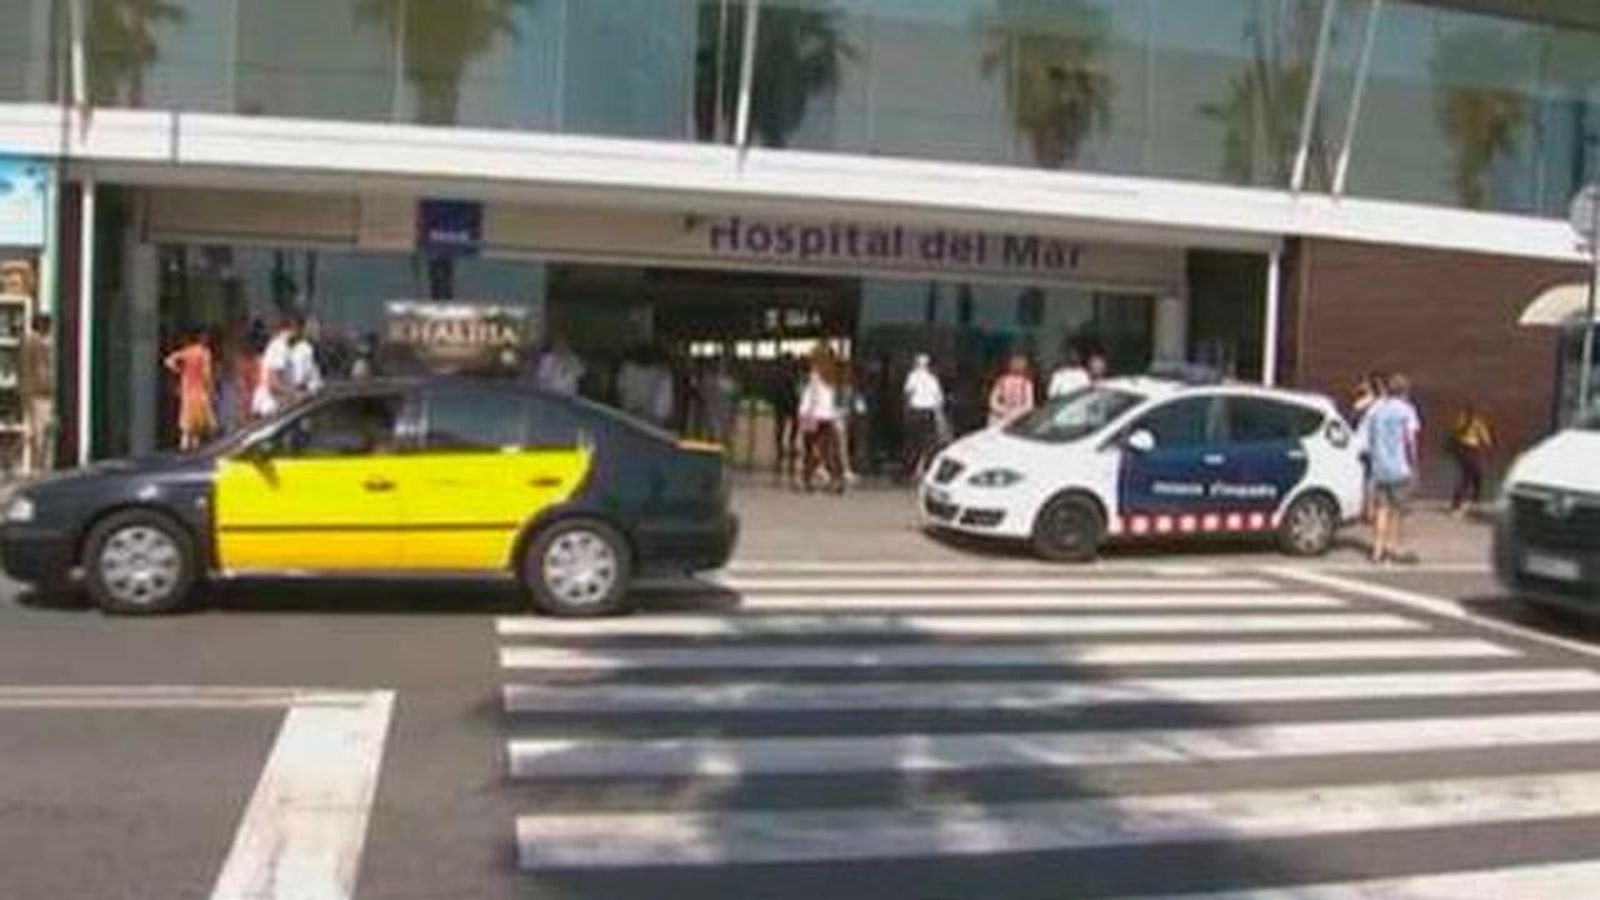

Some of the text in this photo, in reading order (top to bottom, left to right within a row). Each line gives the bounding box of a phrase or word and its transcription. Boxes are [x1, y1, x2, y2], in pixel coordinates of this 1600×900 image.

[709, 216, 1087, 269] Hospital del Mar
